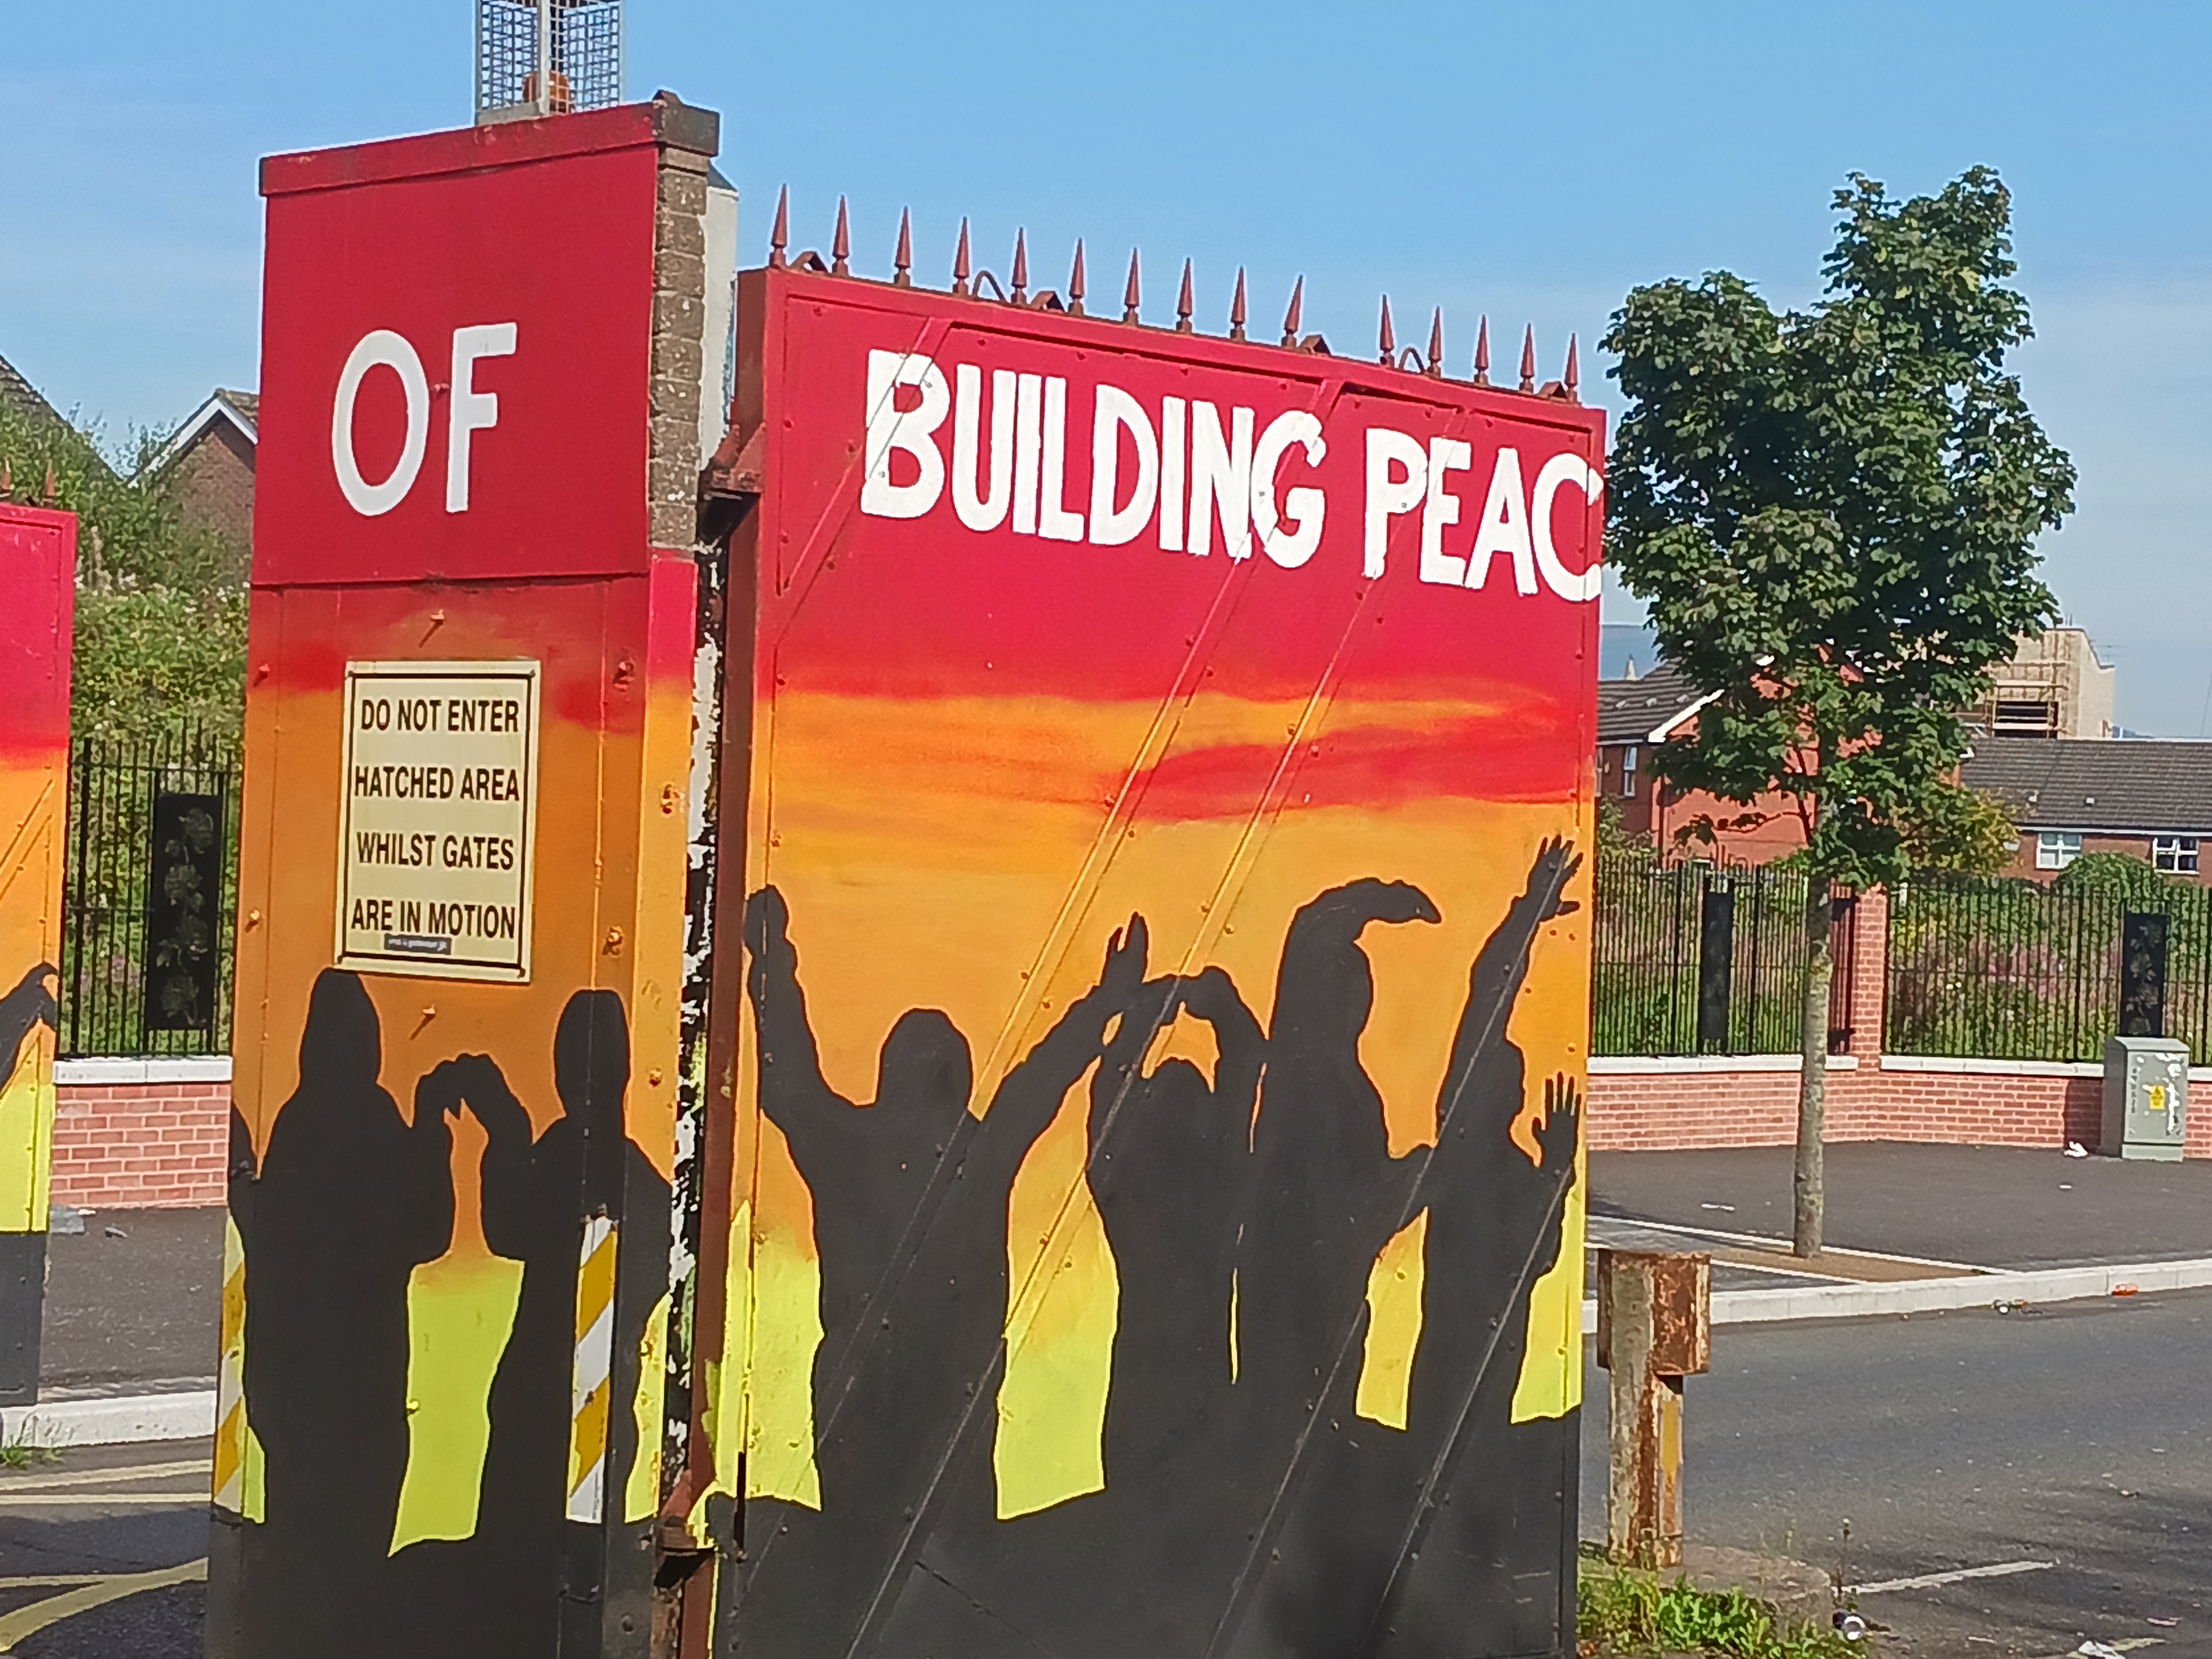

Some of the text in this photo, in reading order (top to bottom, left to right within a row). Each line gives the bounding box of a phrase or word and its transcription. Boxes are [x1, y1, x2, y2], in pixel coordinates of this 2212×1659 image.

[332, 322, 517, 516] OF
[861, 350, 1603, 602] BUILDING PEAC
[361, 699, 519, 732] DO NOT ENTER
[355, 766, 519, 801] HATCHED AREA
[357, 832, 513, 870] WHILST GATES
[351, 899, 516, 939] ARE IN MOTION
